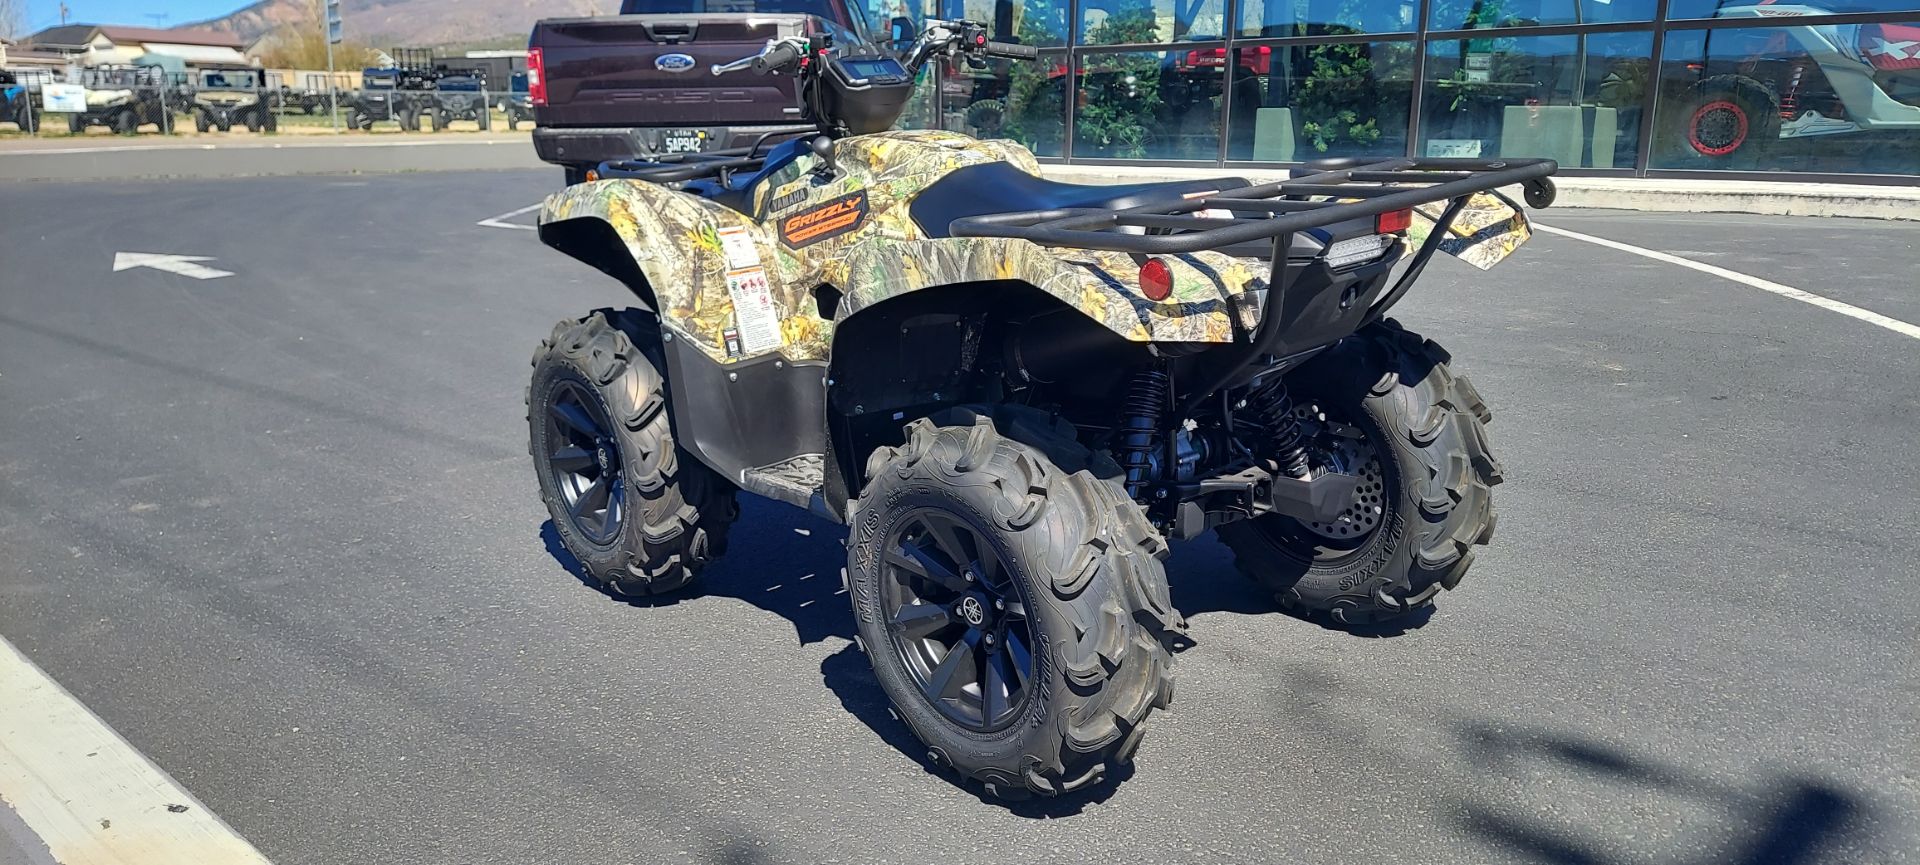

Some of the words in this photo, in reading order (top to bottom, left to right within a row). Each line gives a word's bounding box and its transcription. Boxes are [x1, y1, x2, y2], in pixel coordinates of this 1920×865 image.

[666, 137, 702, 153] 5AP942
[772, 189, 806, 211] YAMAHA
[784, 196, 862, 233] GRIZZLY
[855, 507, 880, 624] MAXXIS
[1338, 511, 1405, 591] MAXXIS
